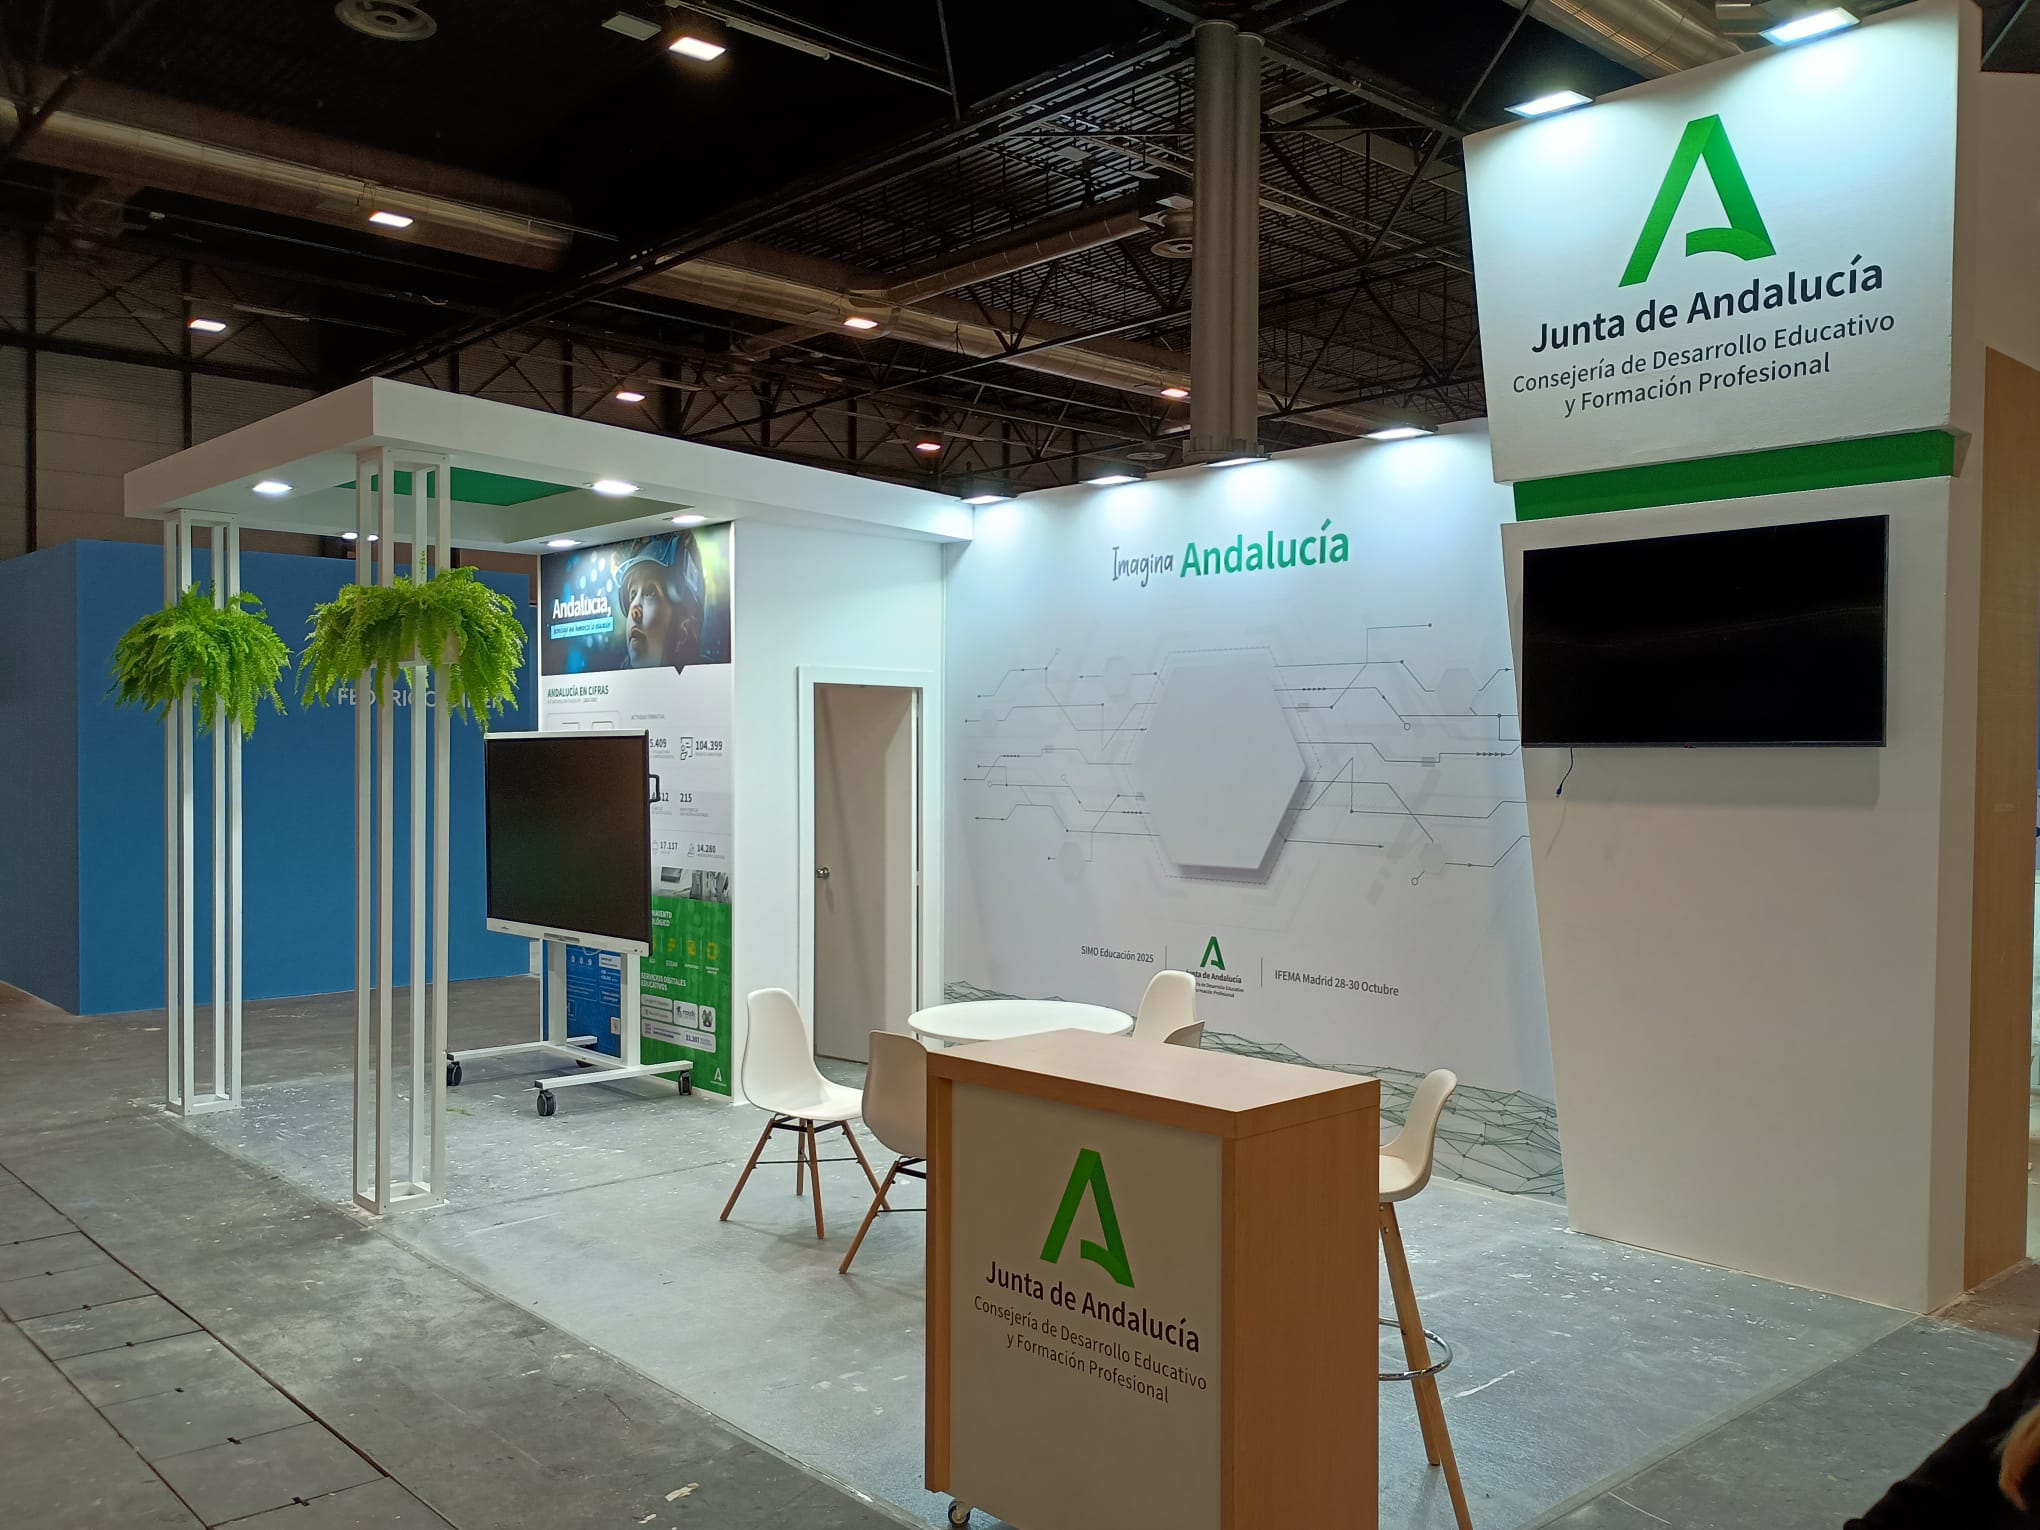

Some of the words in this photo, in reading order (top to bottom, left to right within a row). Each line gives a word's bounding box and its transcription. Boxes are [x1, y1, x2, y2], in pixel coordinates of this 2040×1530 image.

[1531, 312, 1625, 354] Junta
[1635, 298, 1679, 334] de
[1686, 253, 1883, 325] Andalucía
[1513, 357, 1615, 394] Consejería
[1621, 353, 1647, 375] de
[1652, 332, 1767, 370] Desarrollo
[1774, 314, 1895, 350] Educativo
[1564, 398, 1577, 419] y
[1581, 374, 1692, 411] Formación
[1699, 351, 1830, 393] Profesional
[1111, 545, 1175, 589] Imagina
[1179, 517, 1349, 579] Andalucía
[552, 588, 612, 619] Andalucía,
[547, 684, 579, 698] ANDALUCÍA
[579, 686, 588, 696] EN
[588, 684, 609, 696] CIFRAS
[695, 740, 723, 751] 104.399
[679, 792, 693, 803] 215
[1080, 945, 1099, 957] SIMO
[1099, 947, 1136, 961] Educación
[1136, 952, 1154, 963] 2025
[1211, 972, 1242, 984] Andalucía
[1274, 969, 1301, 983] IFEMA
[1302, 973, 1334, 987] Madrid
[1334, 977, 1360, 991] 28-30
[1361, 981, 1399, 996] Octubre
[985, 1260, 1044, 1301] Junta
[1049, 1280, 1077, 1311] de
[1081, 1291, 1200, 1353] Andalucía
[974, 1295, 1038, 1331] Consejería
[1041, 1318, 1058, 1338] de
[1060, 1324, 1131, 1363] Desarrollo
[1134, 1350, 1207, 1390] Educativo
[1006, 1333, 1014, 1349] y
[1017, 1333, 1085, 1373] Formación
[1089, 1359, 1169, 1404] Profesional
